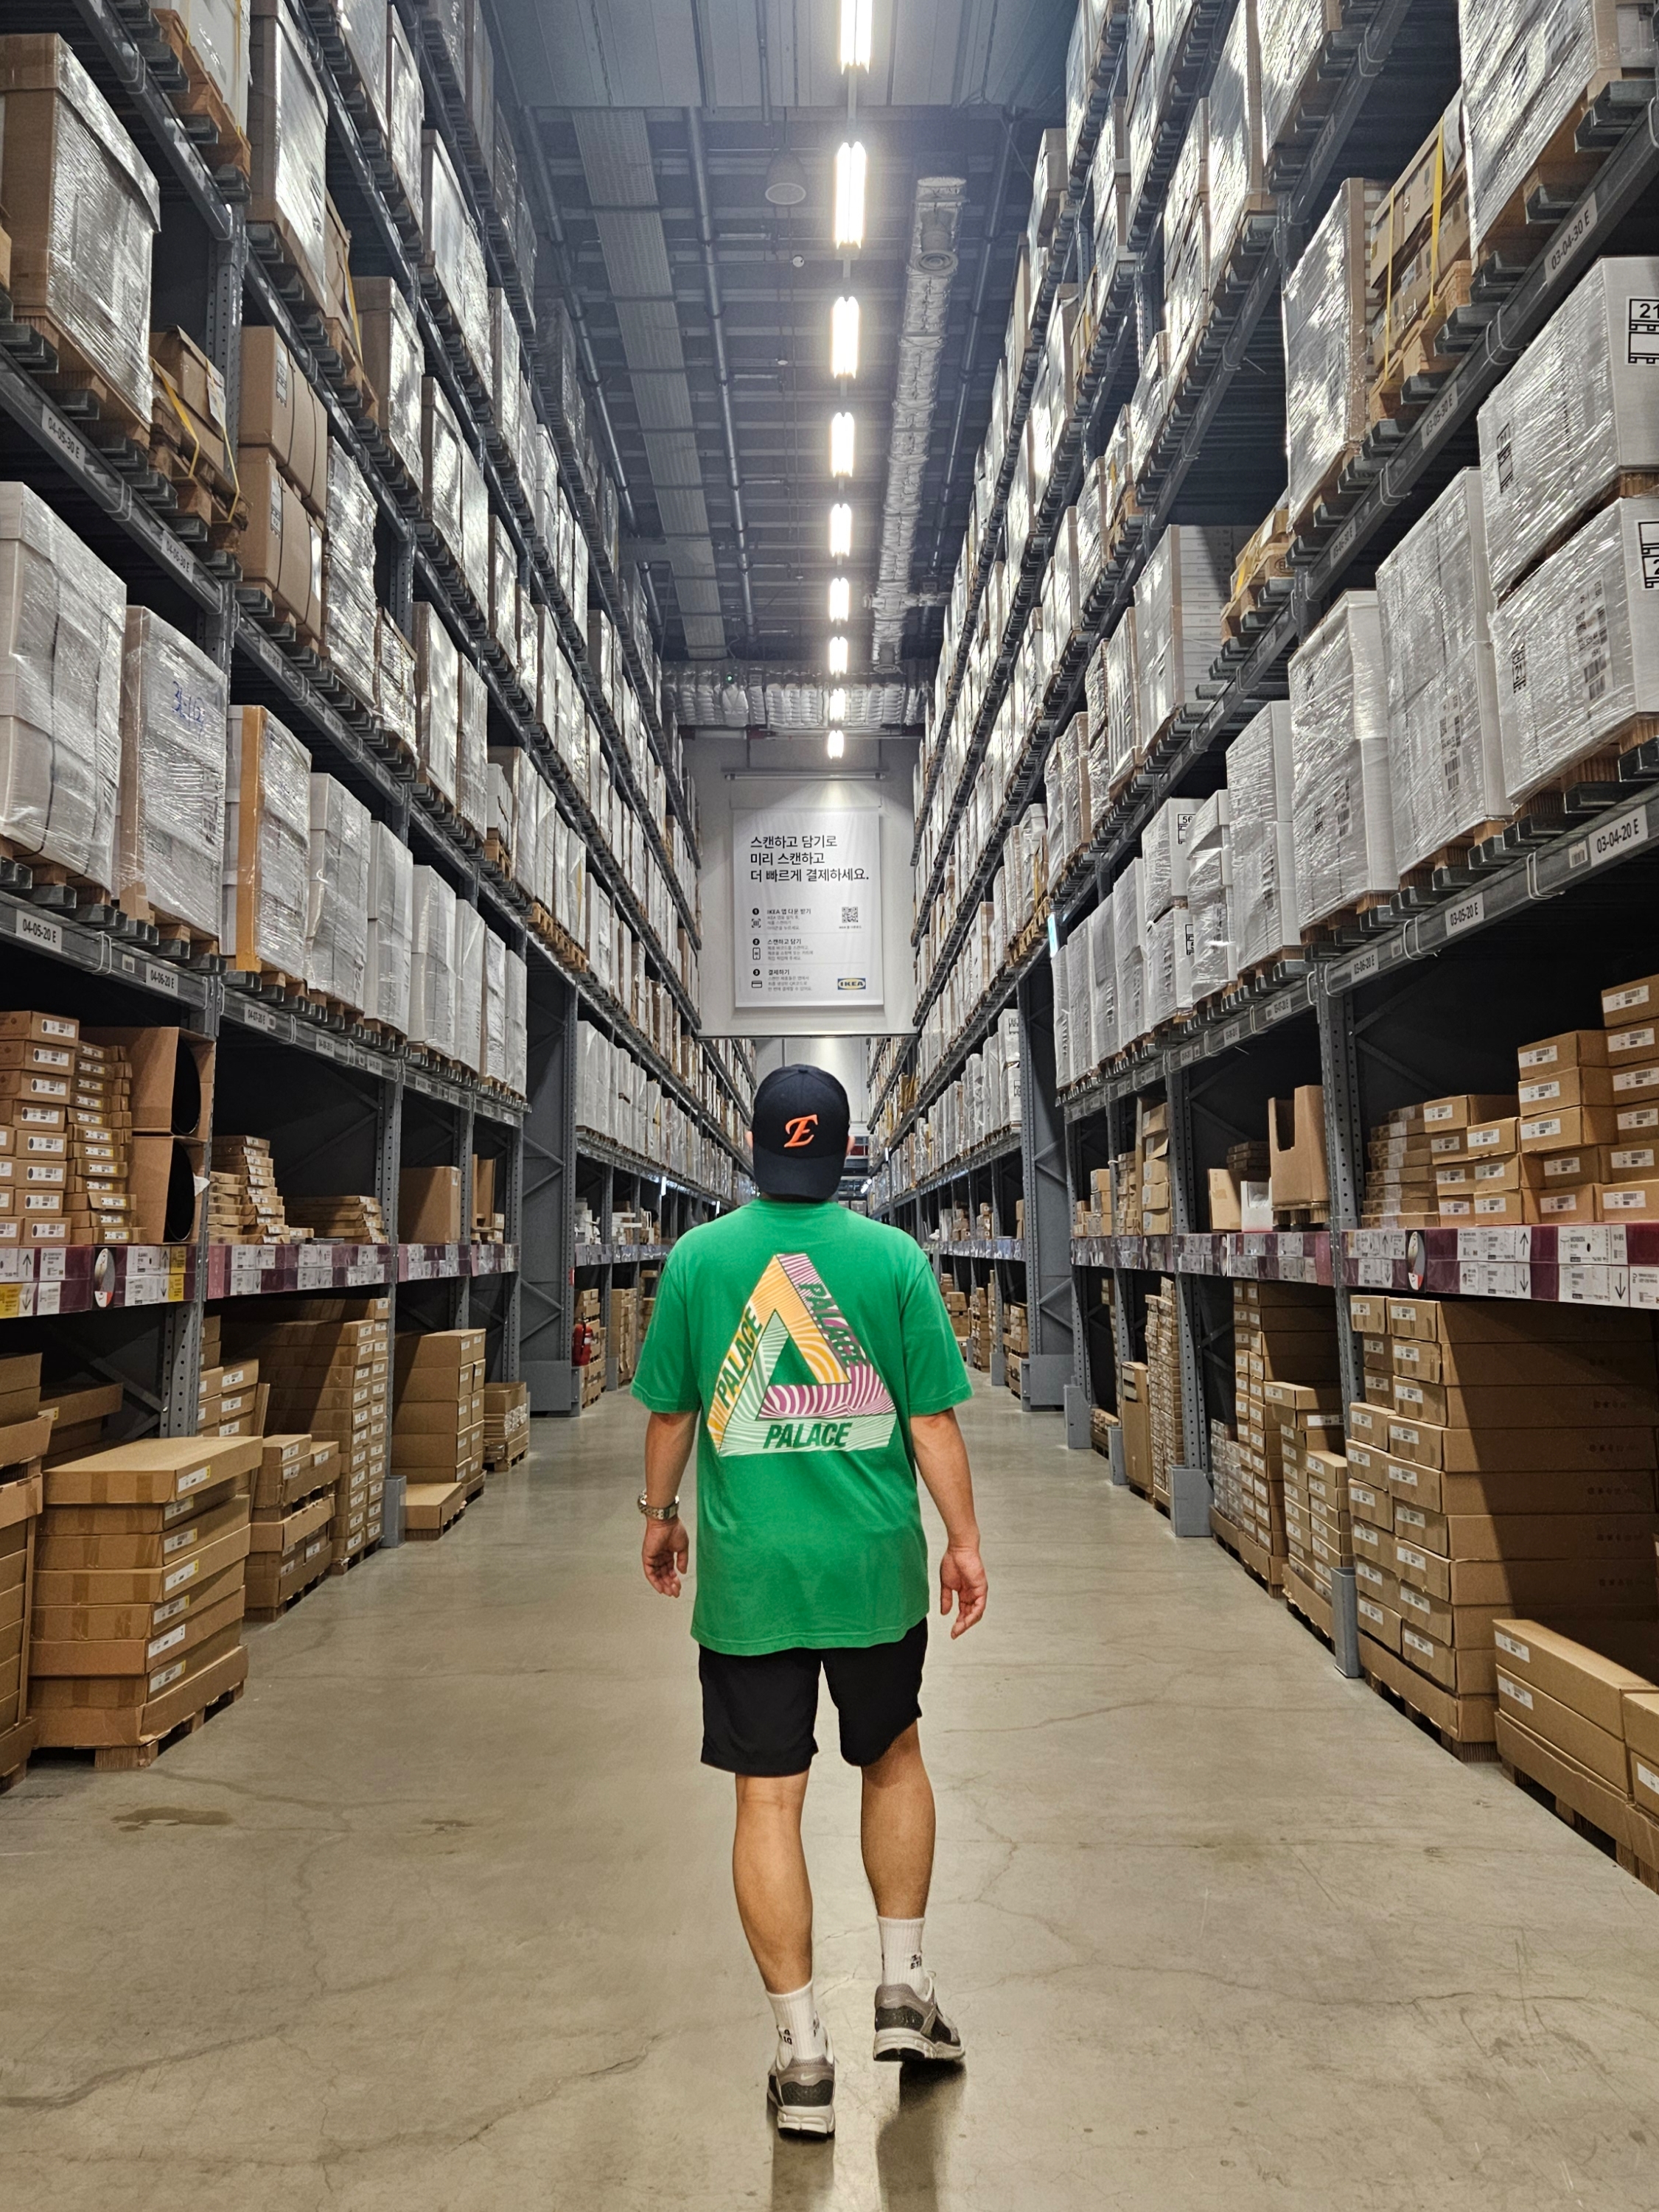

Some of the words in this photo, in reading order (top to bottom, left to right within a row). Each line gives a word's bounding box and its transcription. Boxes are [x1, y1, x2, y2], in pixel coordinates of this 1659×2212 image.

[1551, 220, 1583, 270] 03-04-30
[1584, 209, 1590, 225] E
[48, 416, 74, 454] 04-05-30
[76, 447, 80, 459] E
[750, 836, 798, 849] 스캔하고
[802, 835, 838, 848] 담기로
[1596, 822, 1632, 853] 03-04-20
[1634, 818, 1639, 835] E
[750, 853, 773, 866] 미리
[778, 852, 825, 865] 스캔하고
[750, 869, 762, 883] 더
[766, 869, 802, 882] 빠르게
[806, 868, 869, 882] 결제하세요.
[1450, 905, 1473, 926] 03-05-20
[1474, 902, 1478, 915] E
[22, 918, 51, 941] 04-05-20
[52, 930, 57, 943] E
[171, 977, 175, 989] E
[799, 1281, 868, 1368] PALACE
[716, 1304, 764, 1409] PALACE
[763, 1422, 853, 1449] PALACE
